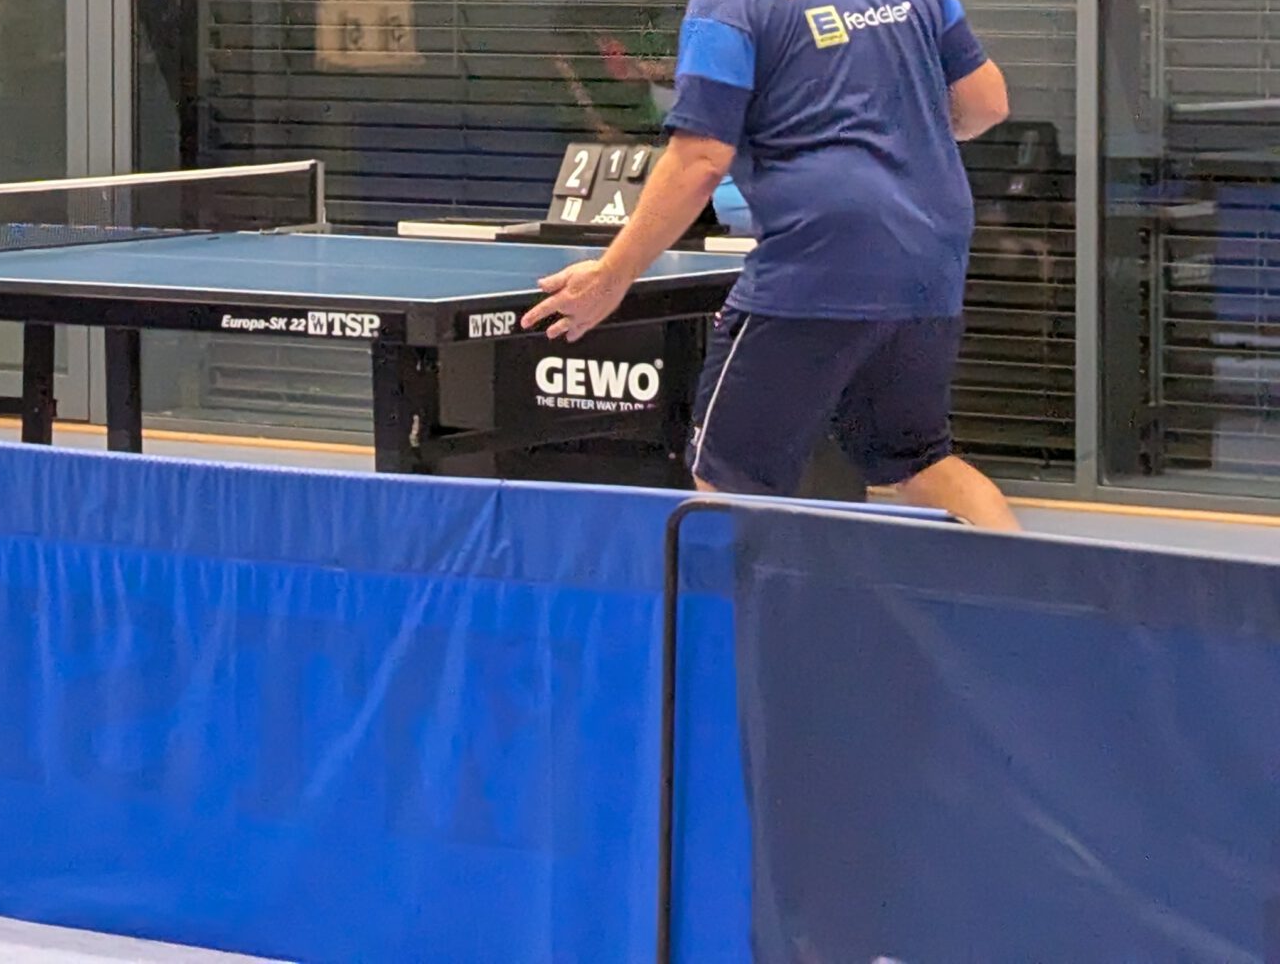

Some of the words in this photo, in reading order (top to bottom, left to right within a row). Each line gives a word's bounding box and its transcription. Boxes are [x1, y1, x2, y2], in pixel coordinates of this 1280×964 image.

[565, 149, 589, 188] 2
[220, 314, 287, 332] Europa-SK
[289, 318, 305, 332] 22
[327, 311, 380, 337] TSP
[482, 310, 515, 336] TSP
[535, 356, 660, 401] GEWO
[535, 395, 554, 407] THE
[556, 397, 594, 410] BETTER
[596, 399, 618, 411] WAY
